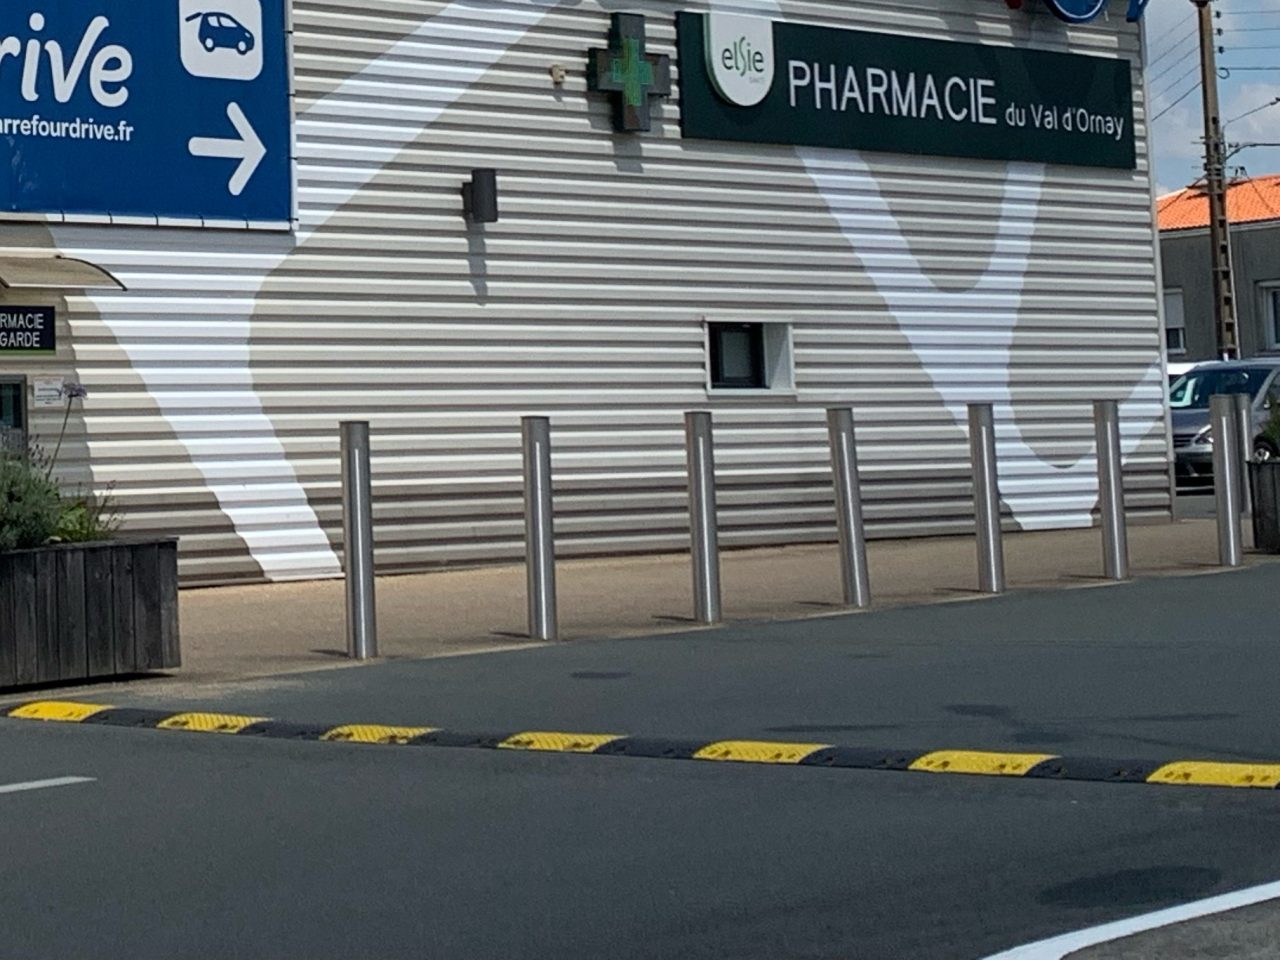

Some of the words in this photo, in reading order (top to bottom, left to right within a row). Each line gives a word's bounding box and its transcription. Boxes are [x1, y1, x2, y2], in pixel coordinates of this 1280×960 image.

[788, 60, 997, 124] PHARMACIE
[1005, 102, 1026, 127] du
[1030, 104, 1058, 130] Val
[1062, 105, 1125, 141] d'Ornay
[0, 332, 41, 347] GARDE
